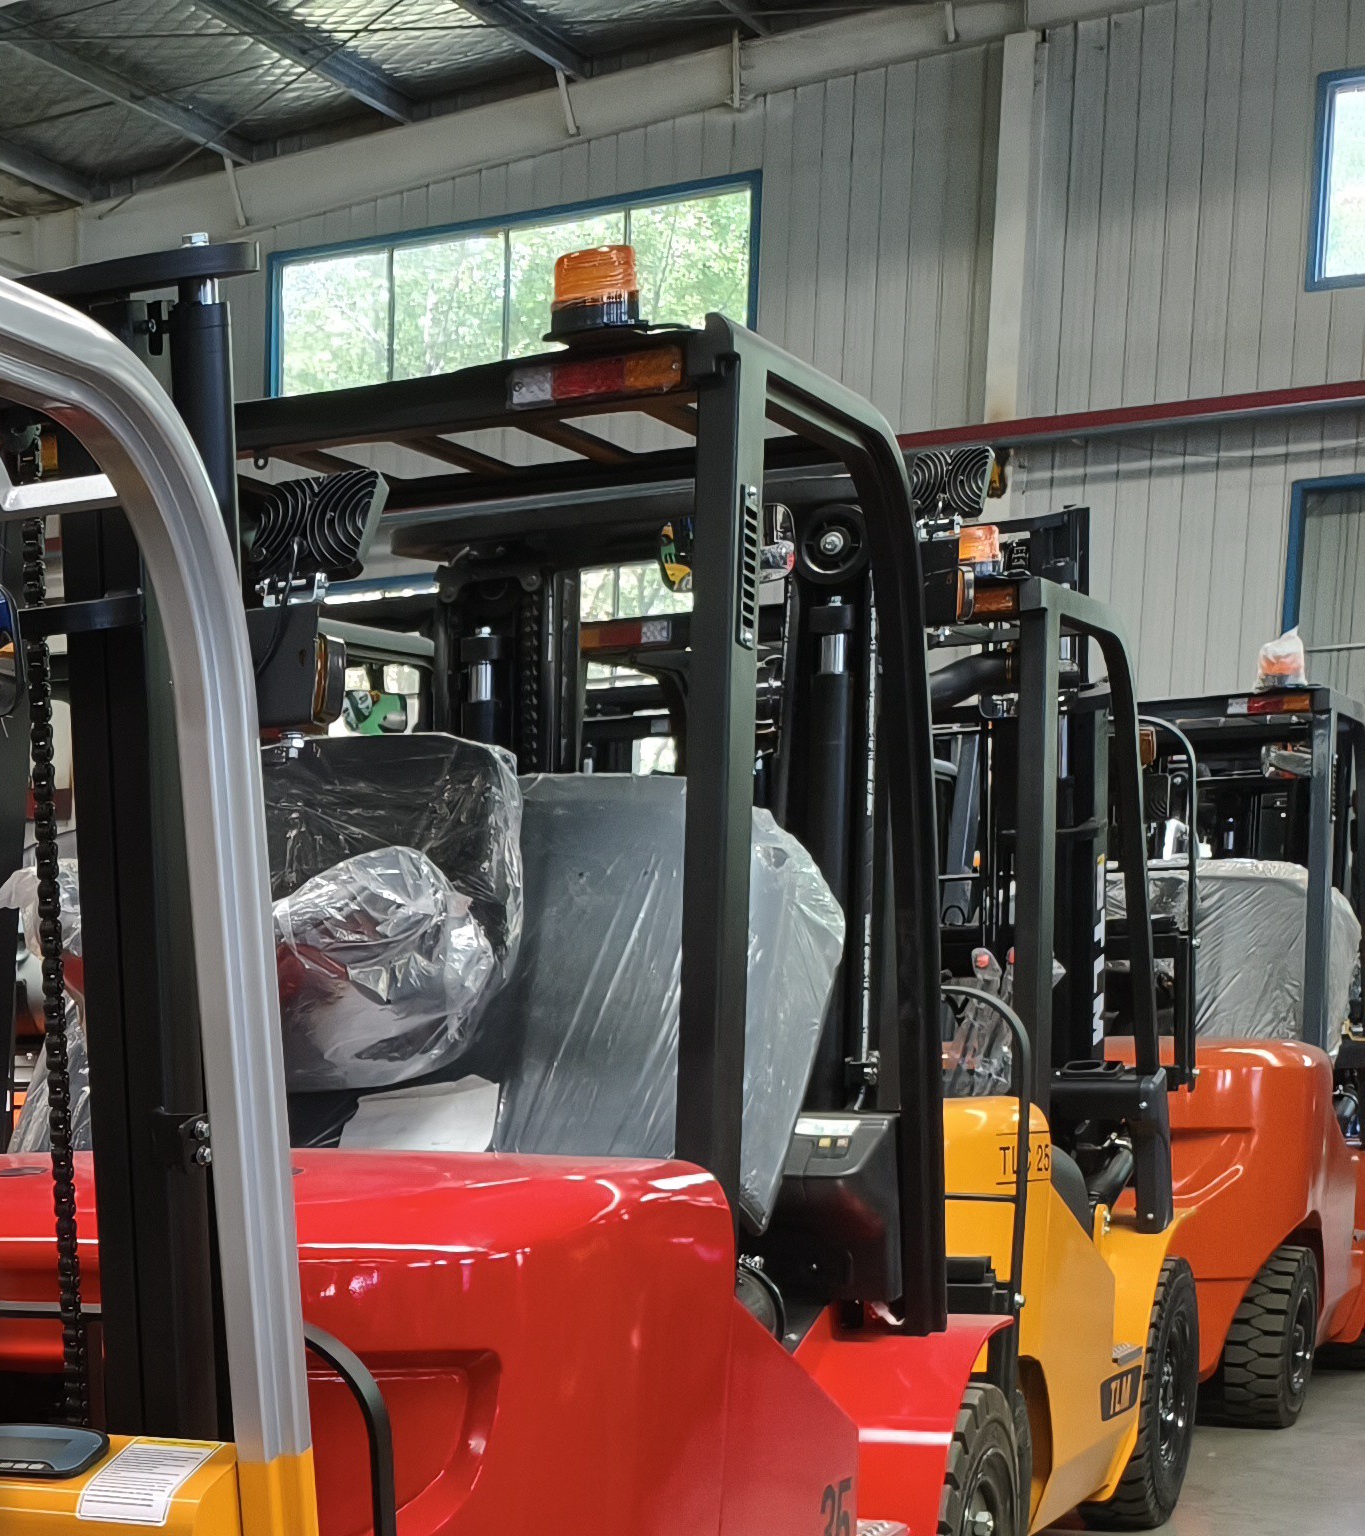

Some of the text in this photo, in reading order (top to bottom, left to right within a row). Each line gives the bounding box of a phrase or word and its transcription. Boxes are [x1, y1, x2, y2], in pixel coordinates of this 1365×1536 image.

[1093, 908, 1106, 1046] TLM
[1036, 1144, 1050, 1172] 25
[1110, 1374, 1132, 1415] TLM
